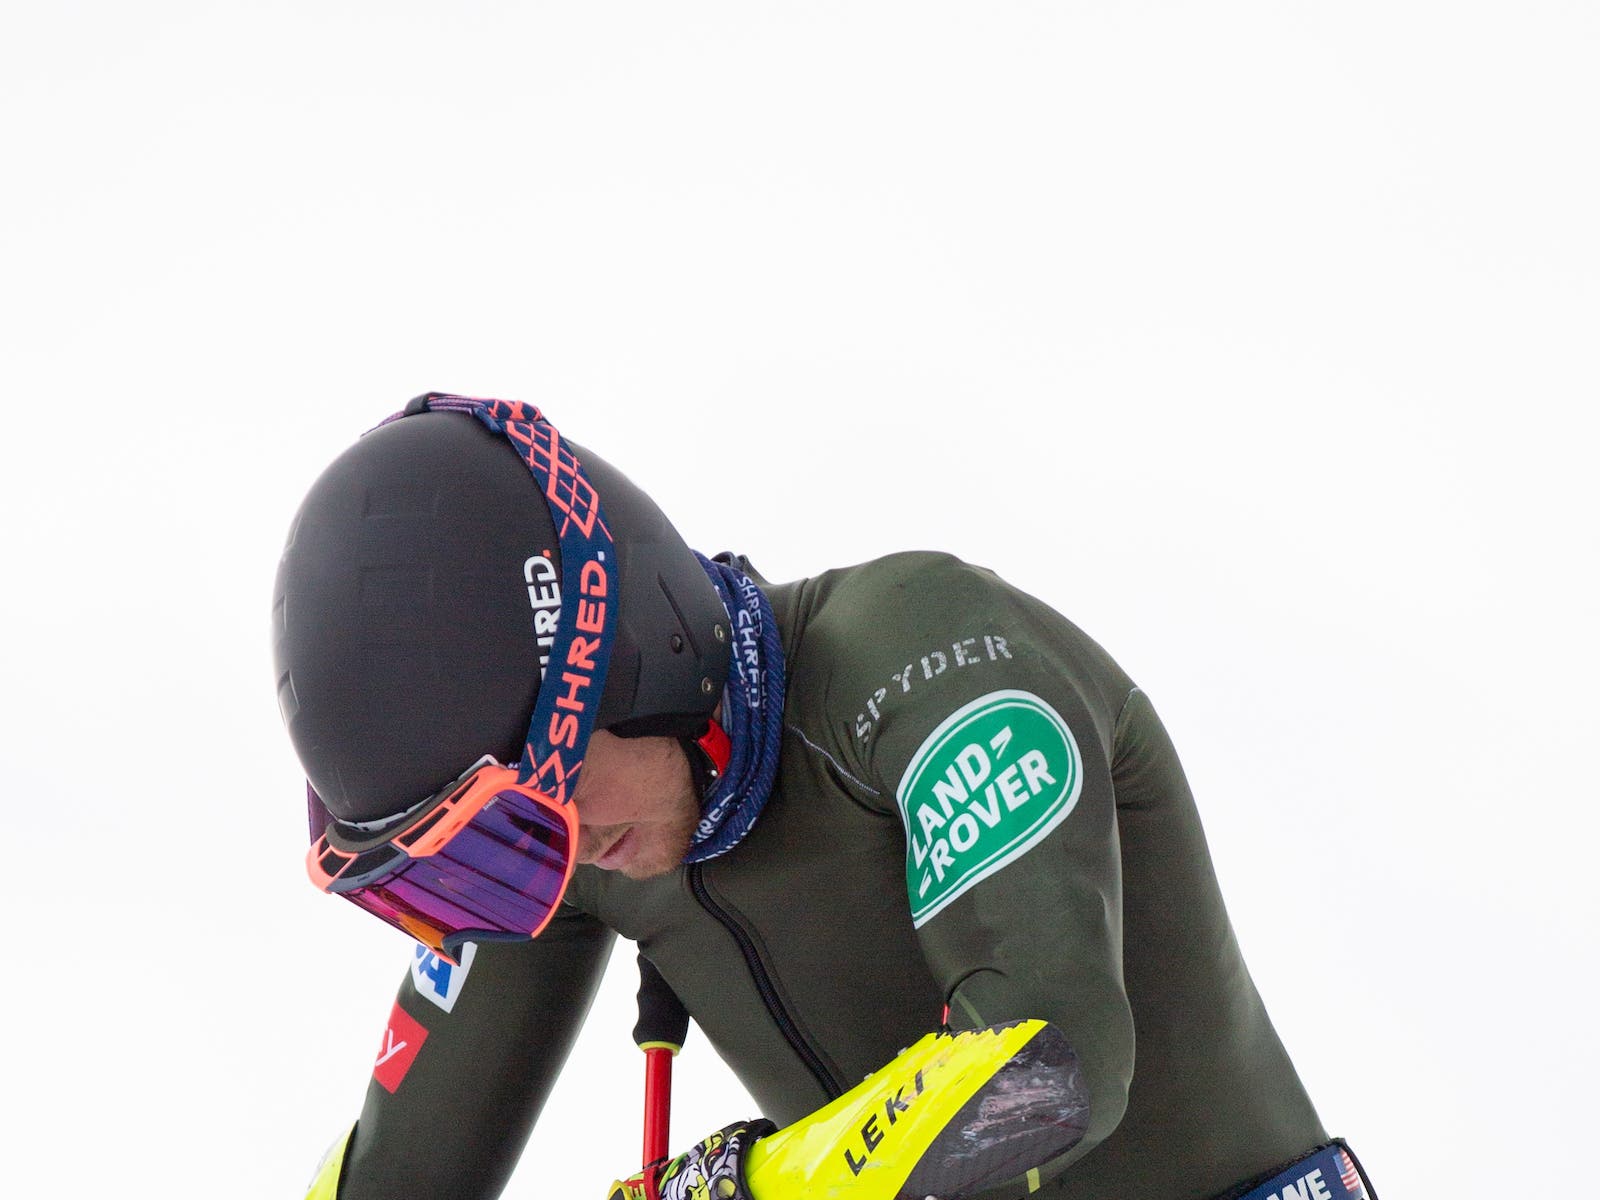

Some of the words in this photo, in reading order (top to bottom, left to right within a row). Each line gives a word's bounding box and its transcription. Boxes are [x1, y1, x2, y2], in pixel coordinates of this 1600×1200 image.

[548, 551, 607, 749] SHRED.
[856, 635, 1013, 743] SPYDER
[912, 742, 991, 870] LAND
[929, 749, 1057, 884] ROVER
[844, 1069, 925, 1177] LEKI
